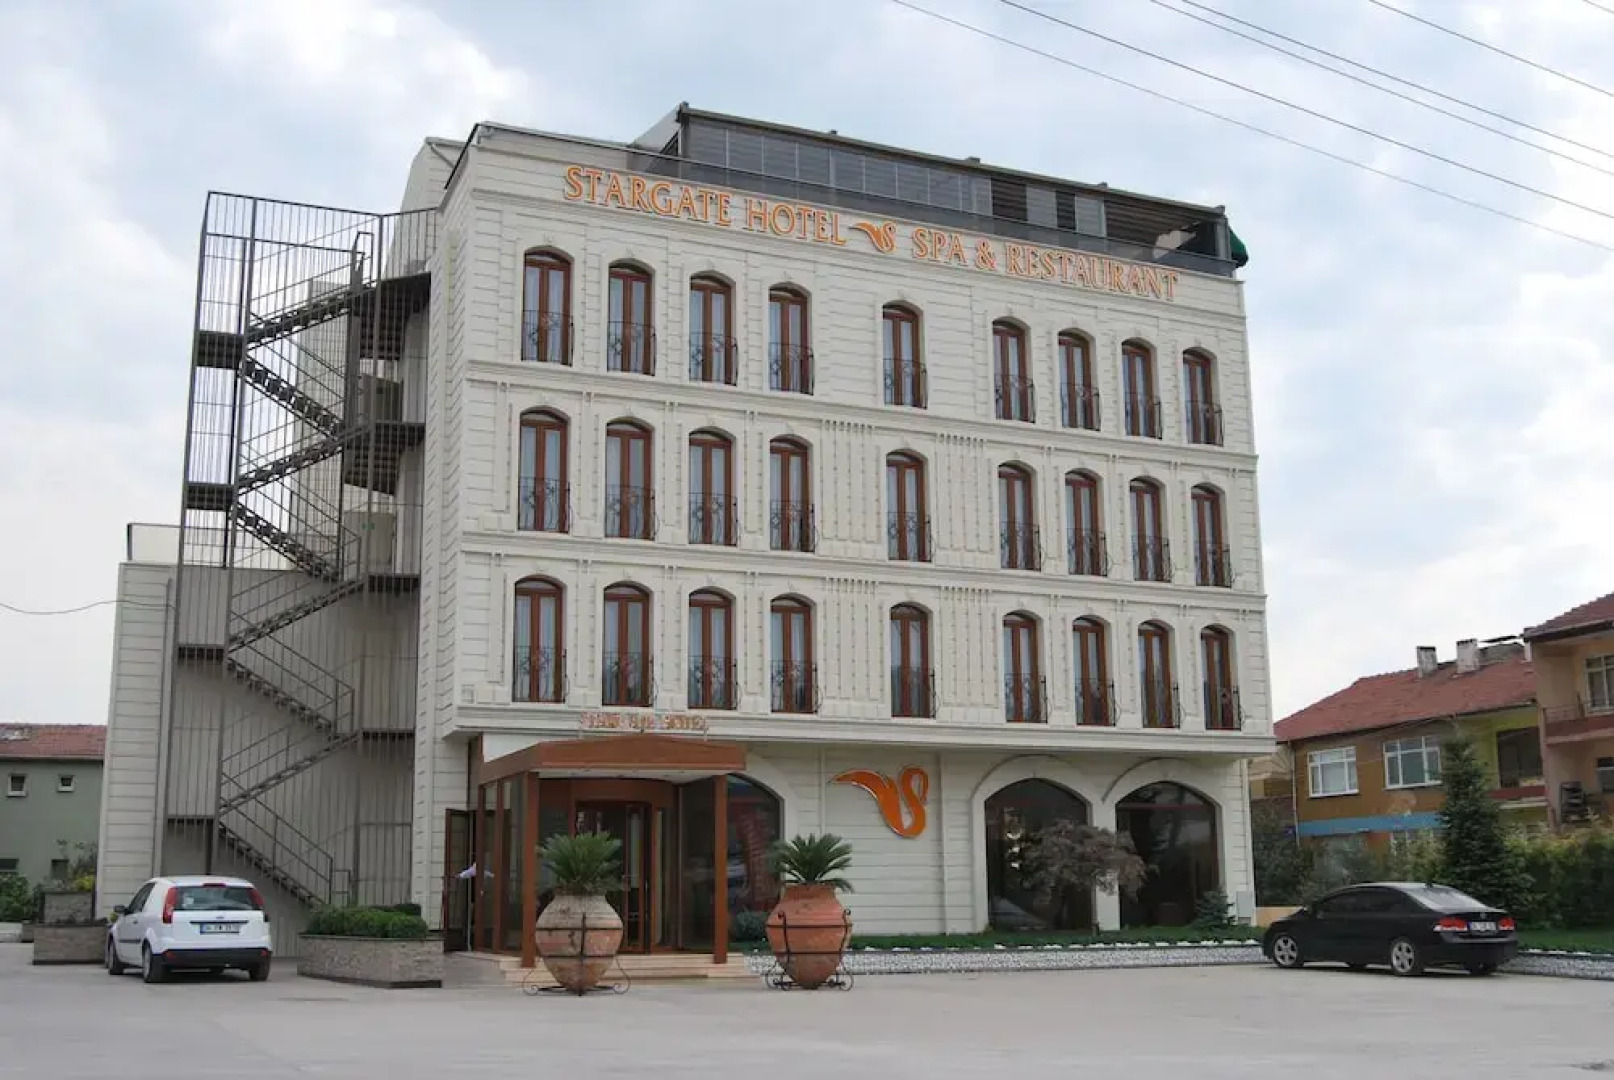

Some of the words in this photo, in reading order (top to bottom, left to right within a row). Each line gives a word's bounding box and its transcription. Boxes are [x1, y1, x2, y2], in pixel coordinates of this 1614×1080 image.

[566, 165, 732, 226] STARGATE
[746, 197, 847, 245] HOTEL
[911, 226, 968, 266] SPA
[974, 237, 997, 271] &
[1006, 243, 1179, 301] RESTAURANT
